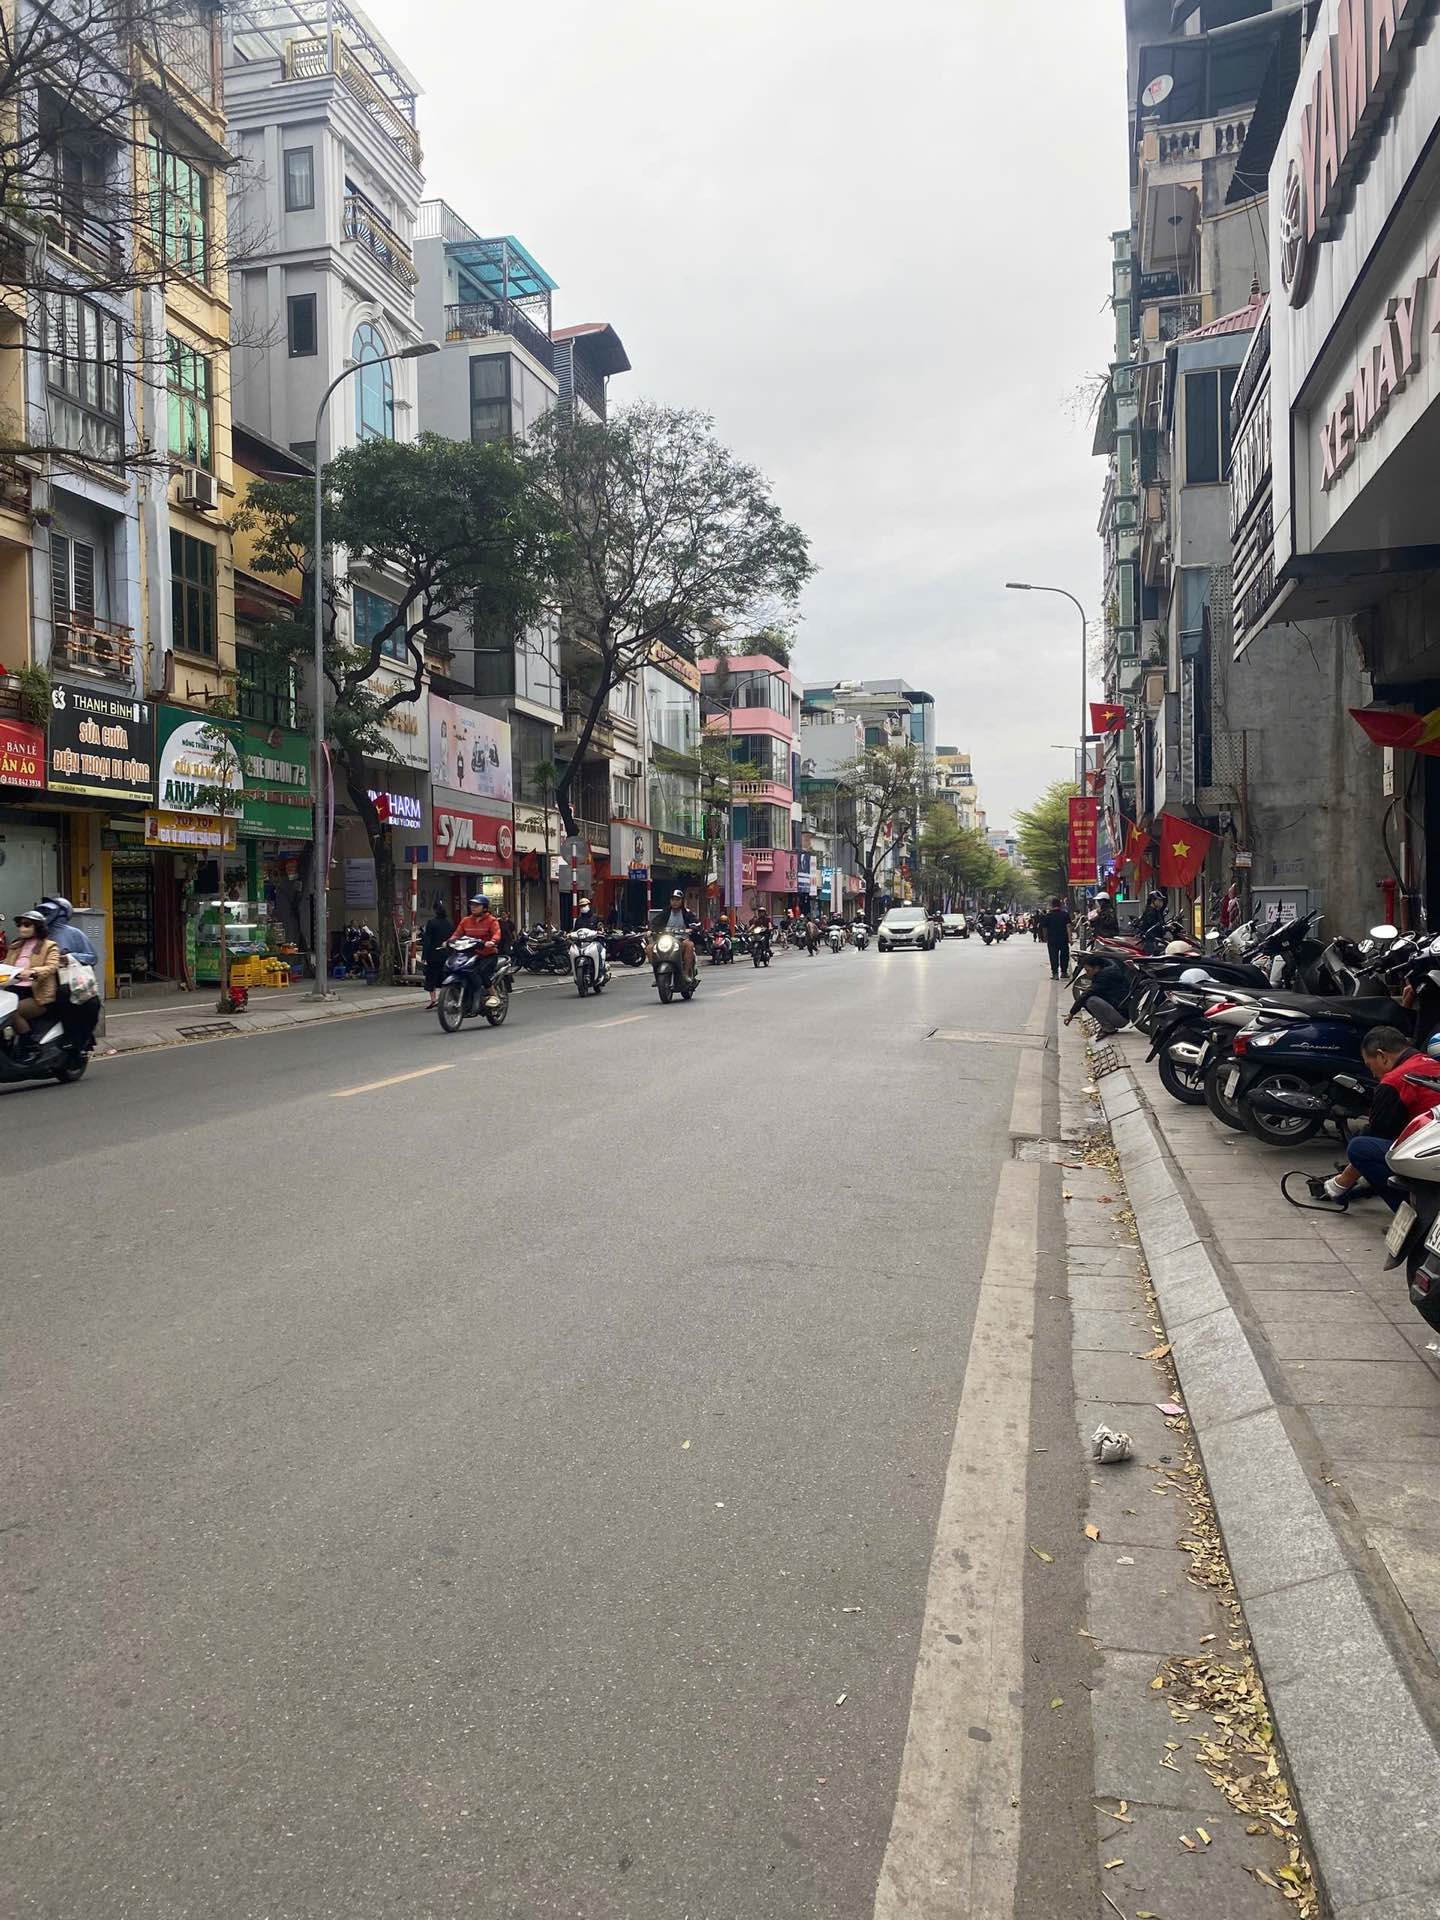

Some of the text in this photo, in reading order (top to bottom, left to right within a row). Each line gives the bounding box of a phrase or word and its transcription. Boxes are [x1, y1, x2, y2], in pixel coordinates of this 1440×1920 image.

[1319, 392, 1352, 493] XE
[73, 694, 133, 718] THANH BÌNH
[79, 717, 129, 750] SỬA CHỮA
[20, 757, 36, 774] ÁO
[53, 747, 150, 786] ĐIỆN THOẠI DI ĐỘNG
[164, 779, 195, 802] ANH
[437, 815, 476, 857] SYM
